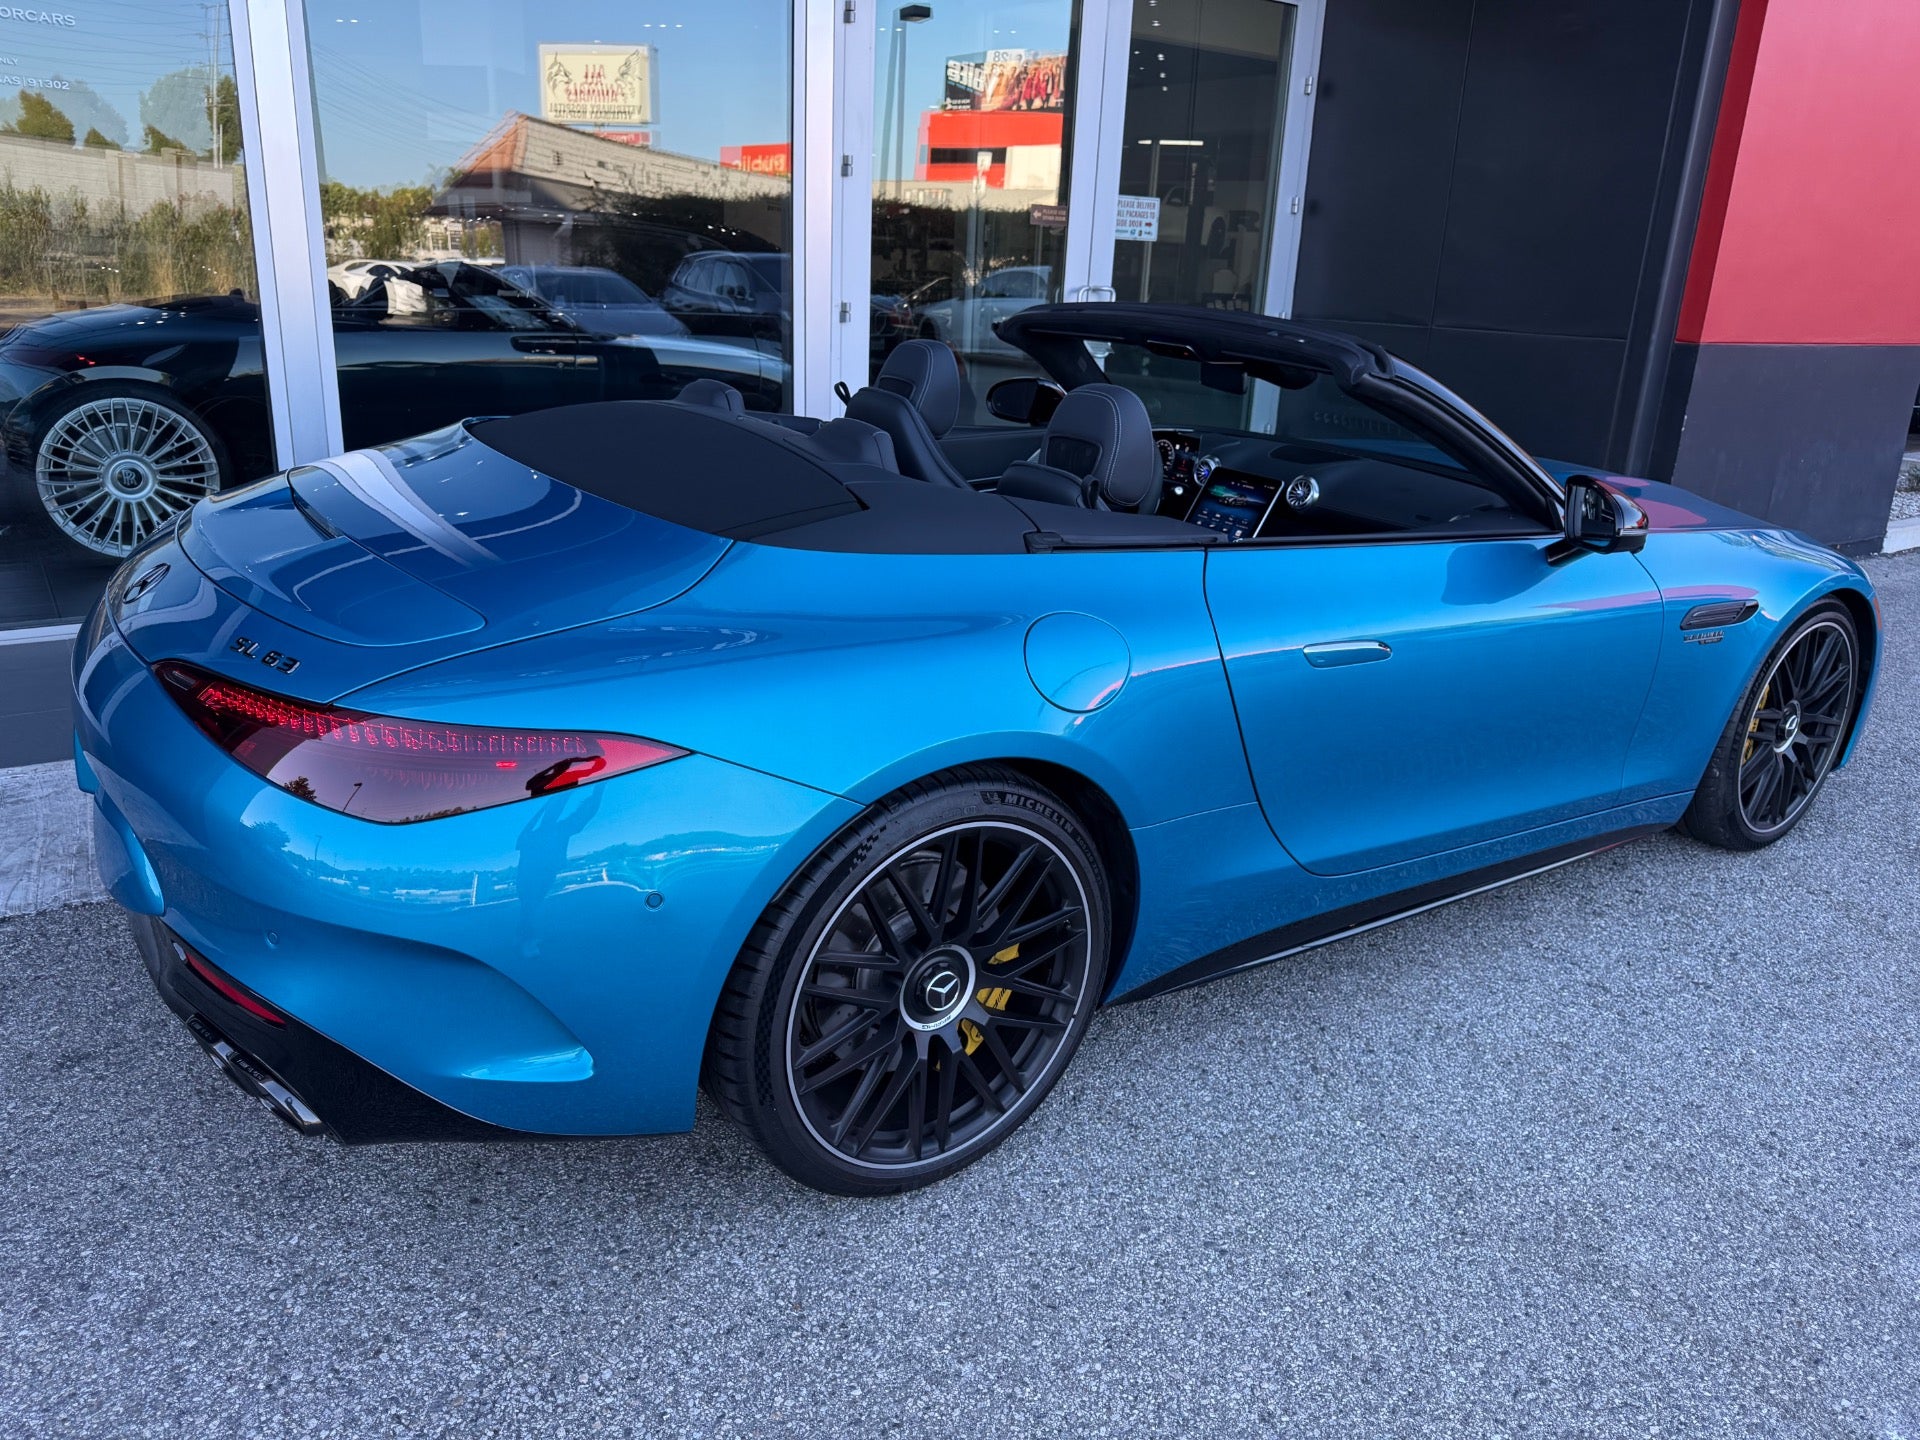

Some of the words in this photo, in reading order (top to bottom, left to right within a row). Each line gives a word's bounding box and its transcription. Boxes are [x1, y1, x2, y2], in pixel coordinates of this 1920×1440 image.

[1117, 200, 1135, 209] PLEASE
[1136, 201, 1156, 210] DELIVER
[1126, 210, 1149, 219] PACKAGES
[1128, 219, 1143, 228] DOOR
[229, 636, 259, 659] SL
[261, 650, 301, 675] 63
[1004, 793, 1073, 833] MICHELIN
